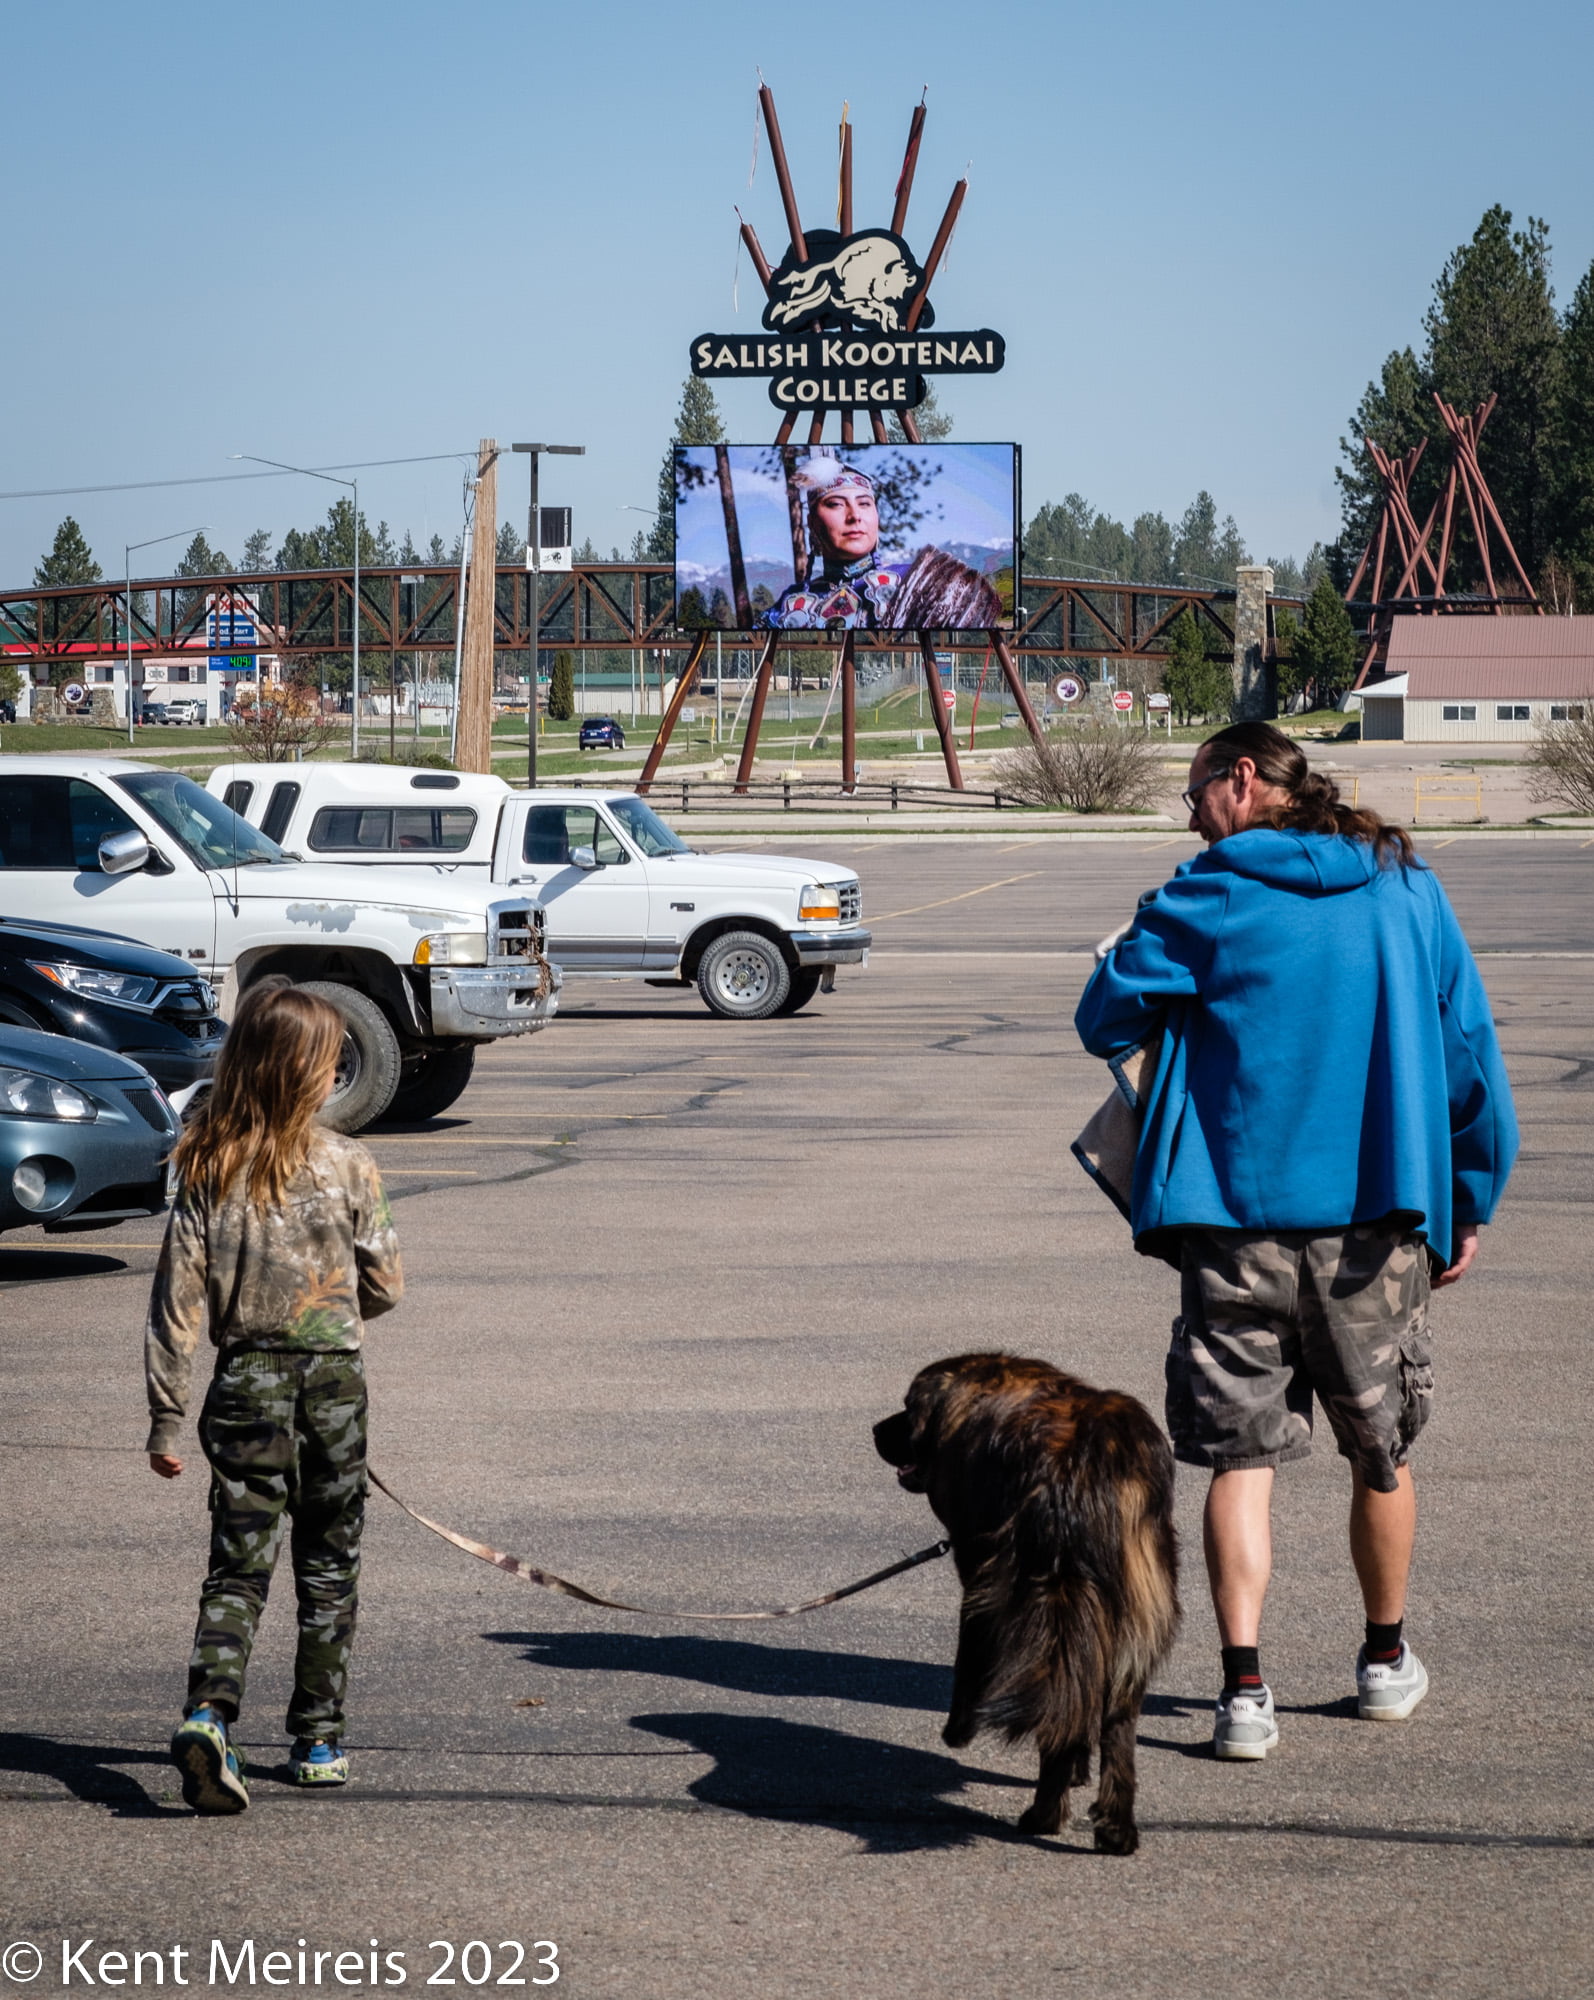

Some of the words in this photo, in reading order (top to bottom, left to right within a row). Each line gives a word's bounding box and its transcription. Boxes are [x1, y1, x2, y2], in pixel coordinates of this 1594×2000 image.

[697, 341, 808, 369] SALISH
[822, 338, 994, 367] KOOTENAI
[776, 376, 907, 403] COLLEGE
[1366, 1671, 1385, 1681] NIKE
[1231, 1703, 1250, 1713] NIKE
